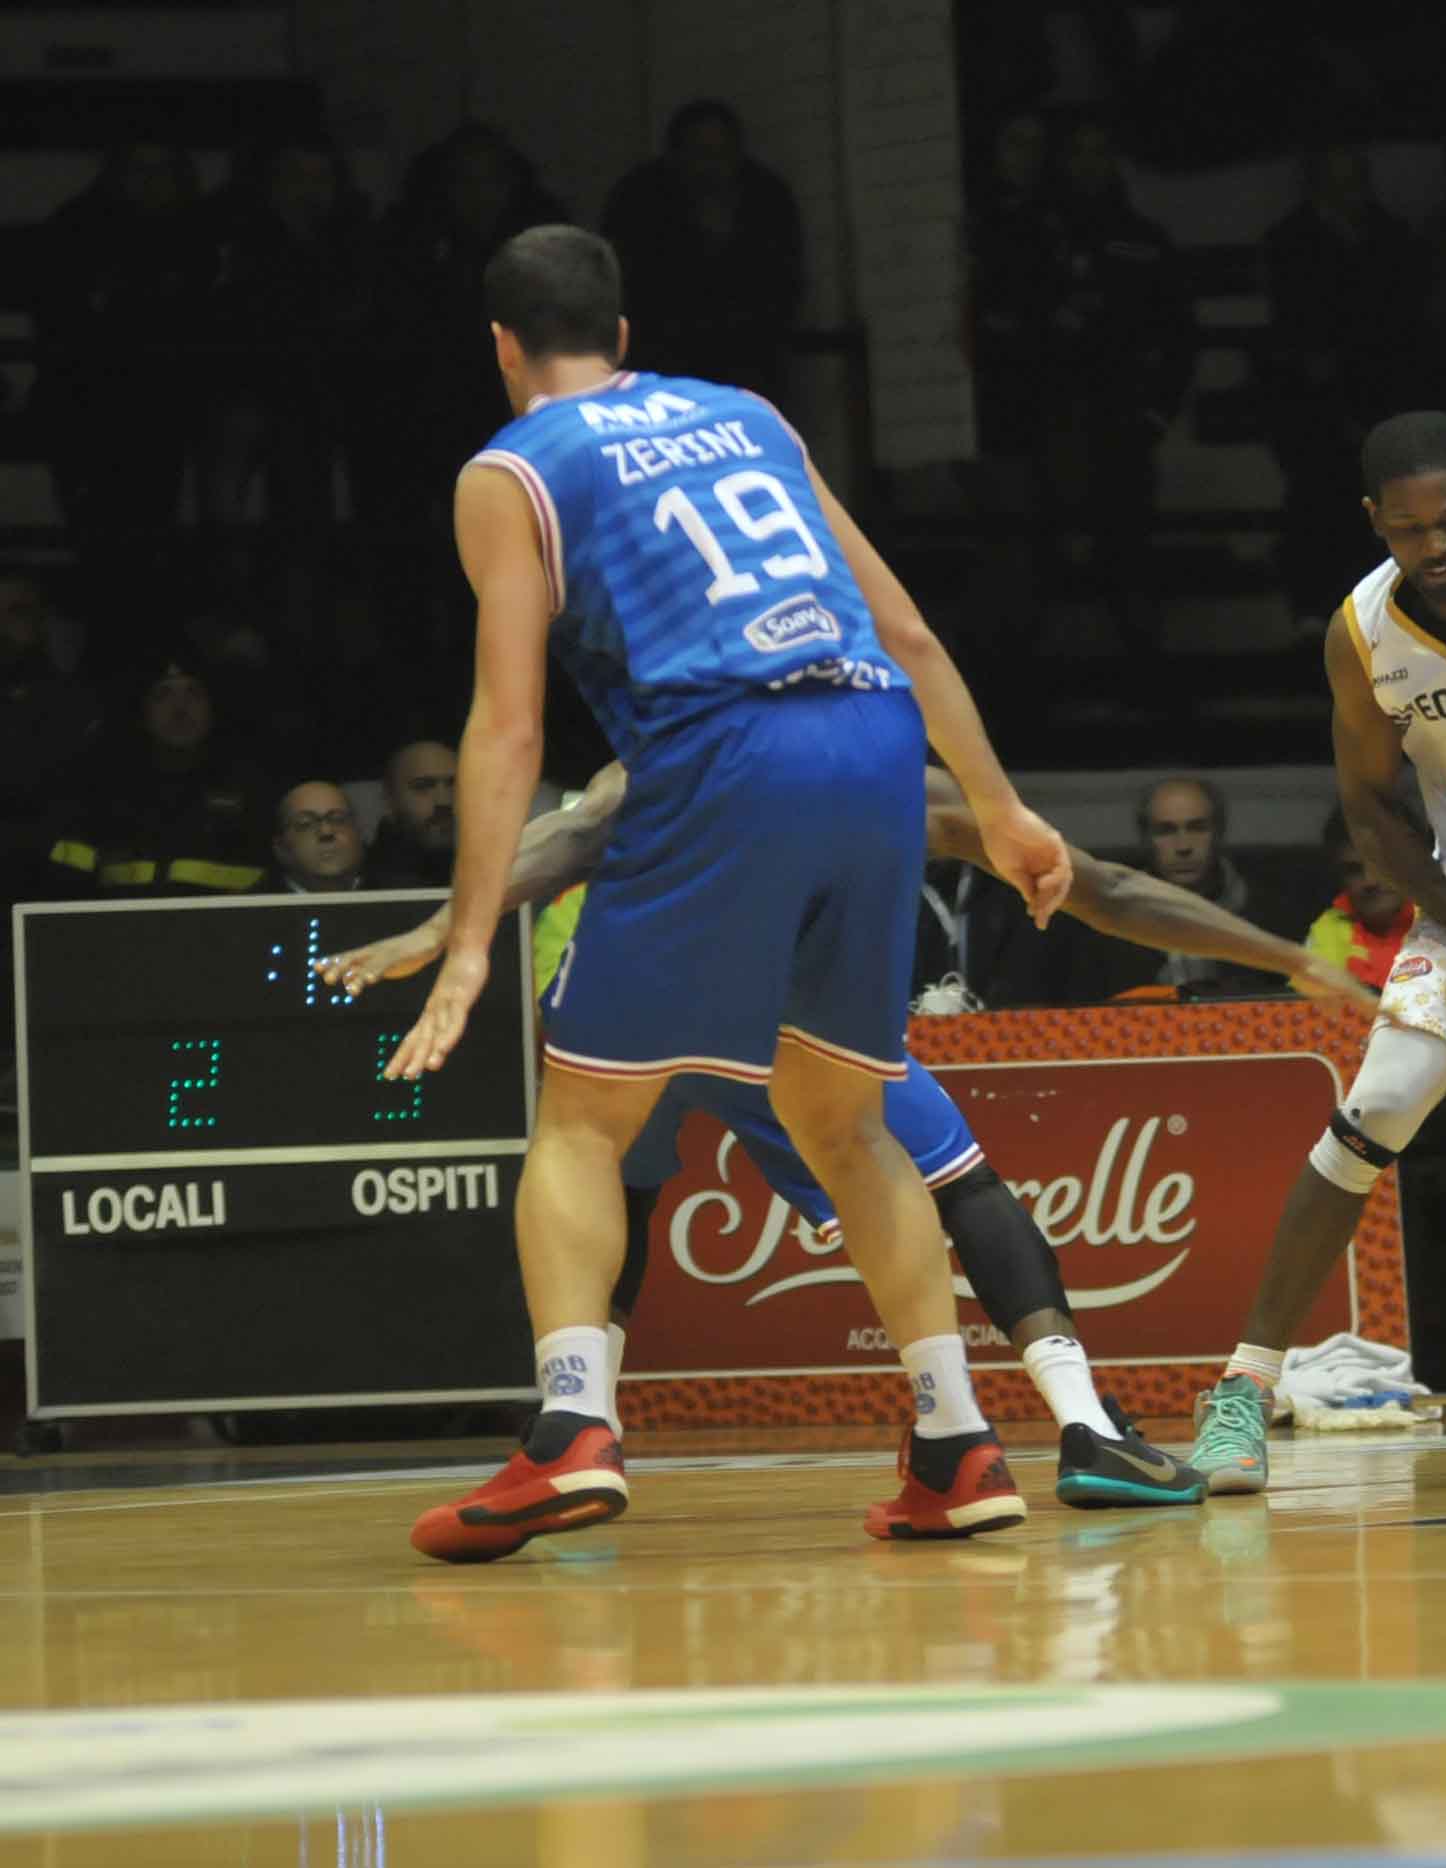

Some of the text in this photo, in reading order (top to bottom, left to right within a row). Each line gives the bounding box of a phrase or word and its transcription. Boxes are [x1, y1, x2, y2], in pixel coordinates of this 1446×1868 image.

[601, 420, 764, 485] ZERINI
[653, 470, 828, 607] 19
[168, 1039, 222, 1128] 2
[61, 1164, 499, 1236] LOCALI OSPITI
